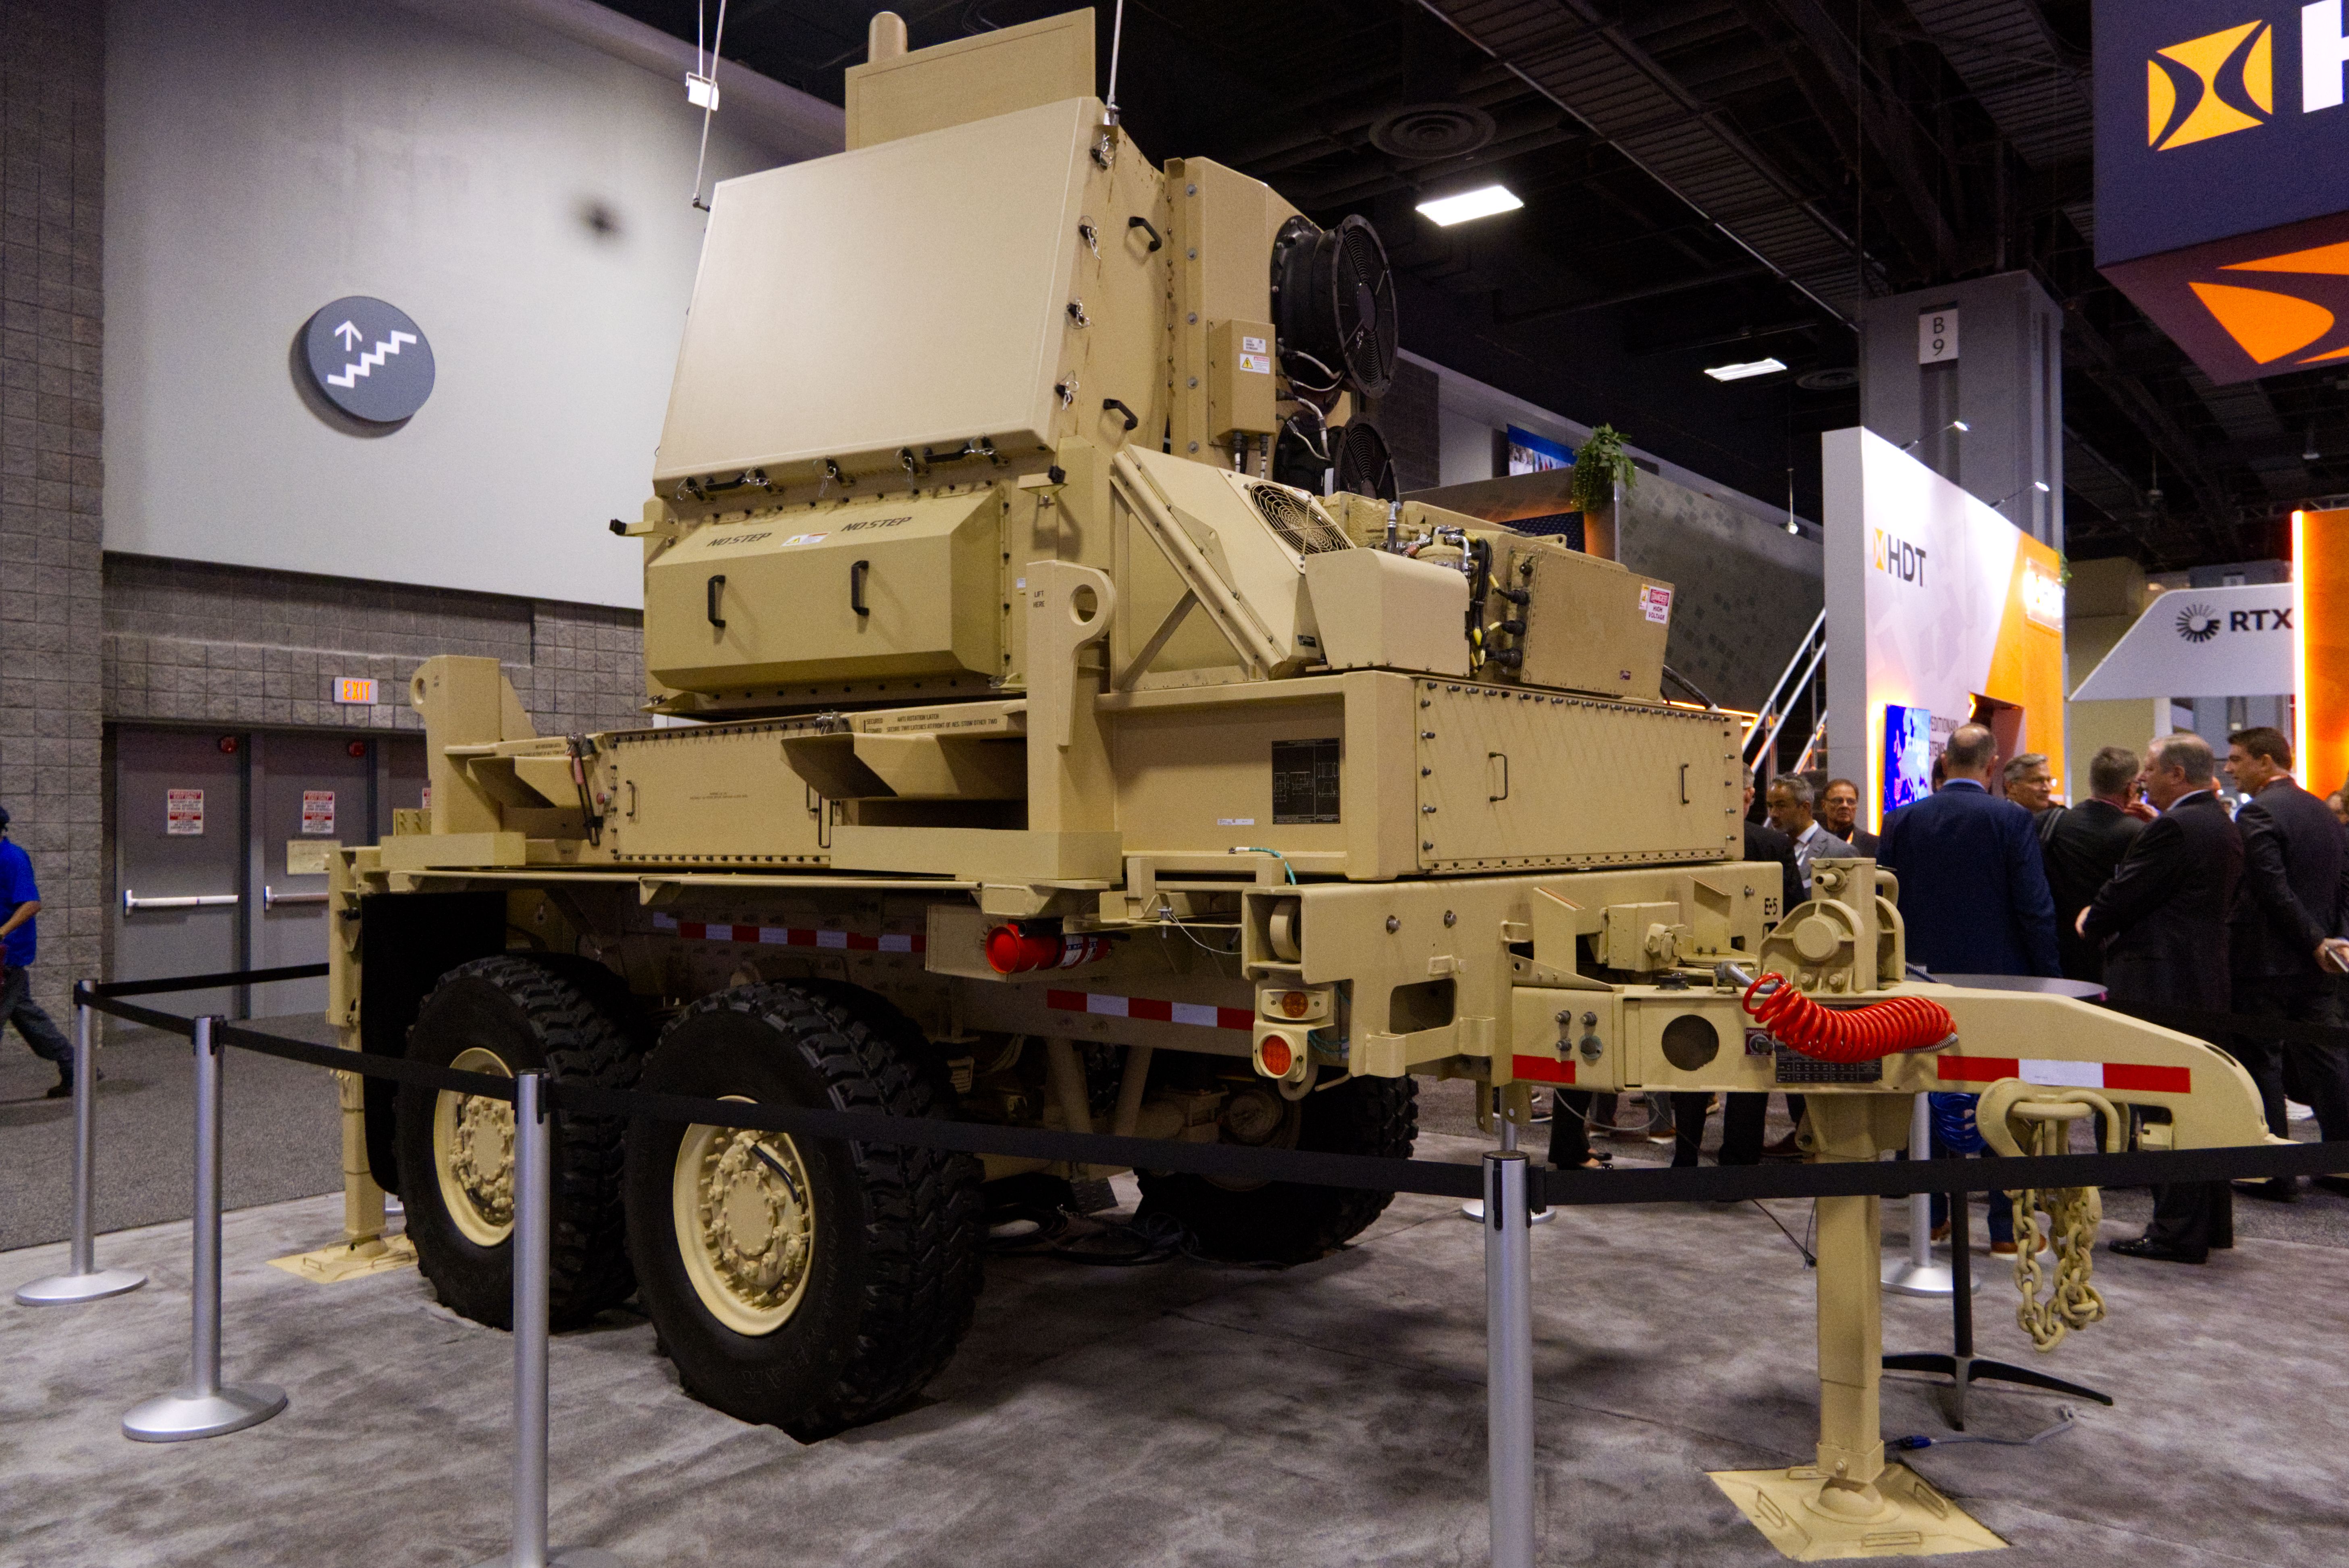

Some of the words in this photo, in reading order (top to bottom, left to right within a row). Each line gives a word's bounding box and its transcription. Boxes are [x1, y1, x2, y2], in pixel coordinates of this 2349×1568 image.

[1933, 317, 1944, 334] B
[1933, 339, 1944, 355] 9
[865, 517, 912, 529] STEP
[728, 532, 772, 544] STEP
[1887, 534, 1926, 587] HDT
[1648, 612, 1665, 621] VOLTAGE
[2230, 608, 2293, 631] RTX
[343, 680, 371, 701] EXIT
[1765, 897, 1777, 916] E-5
